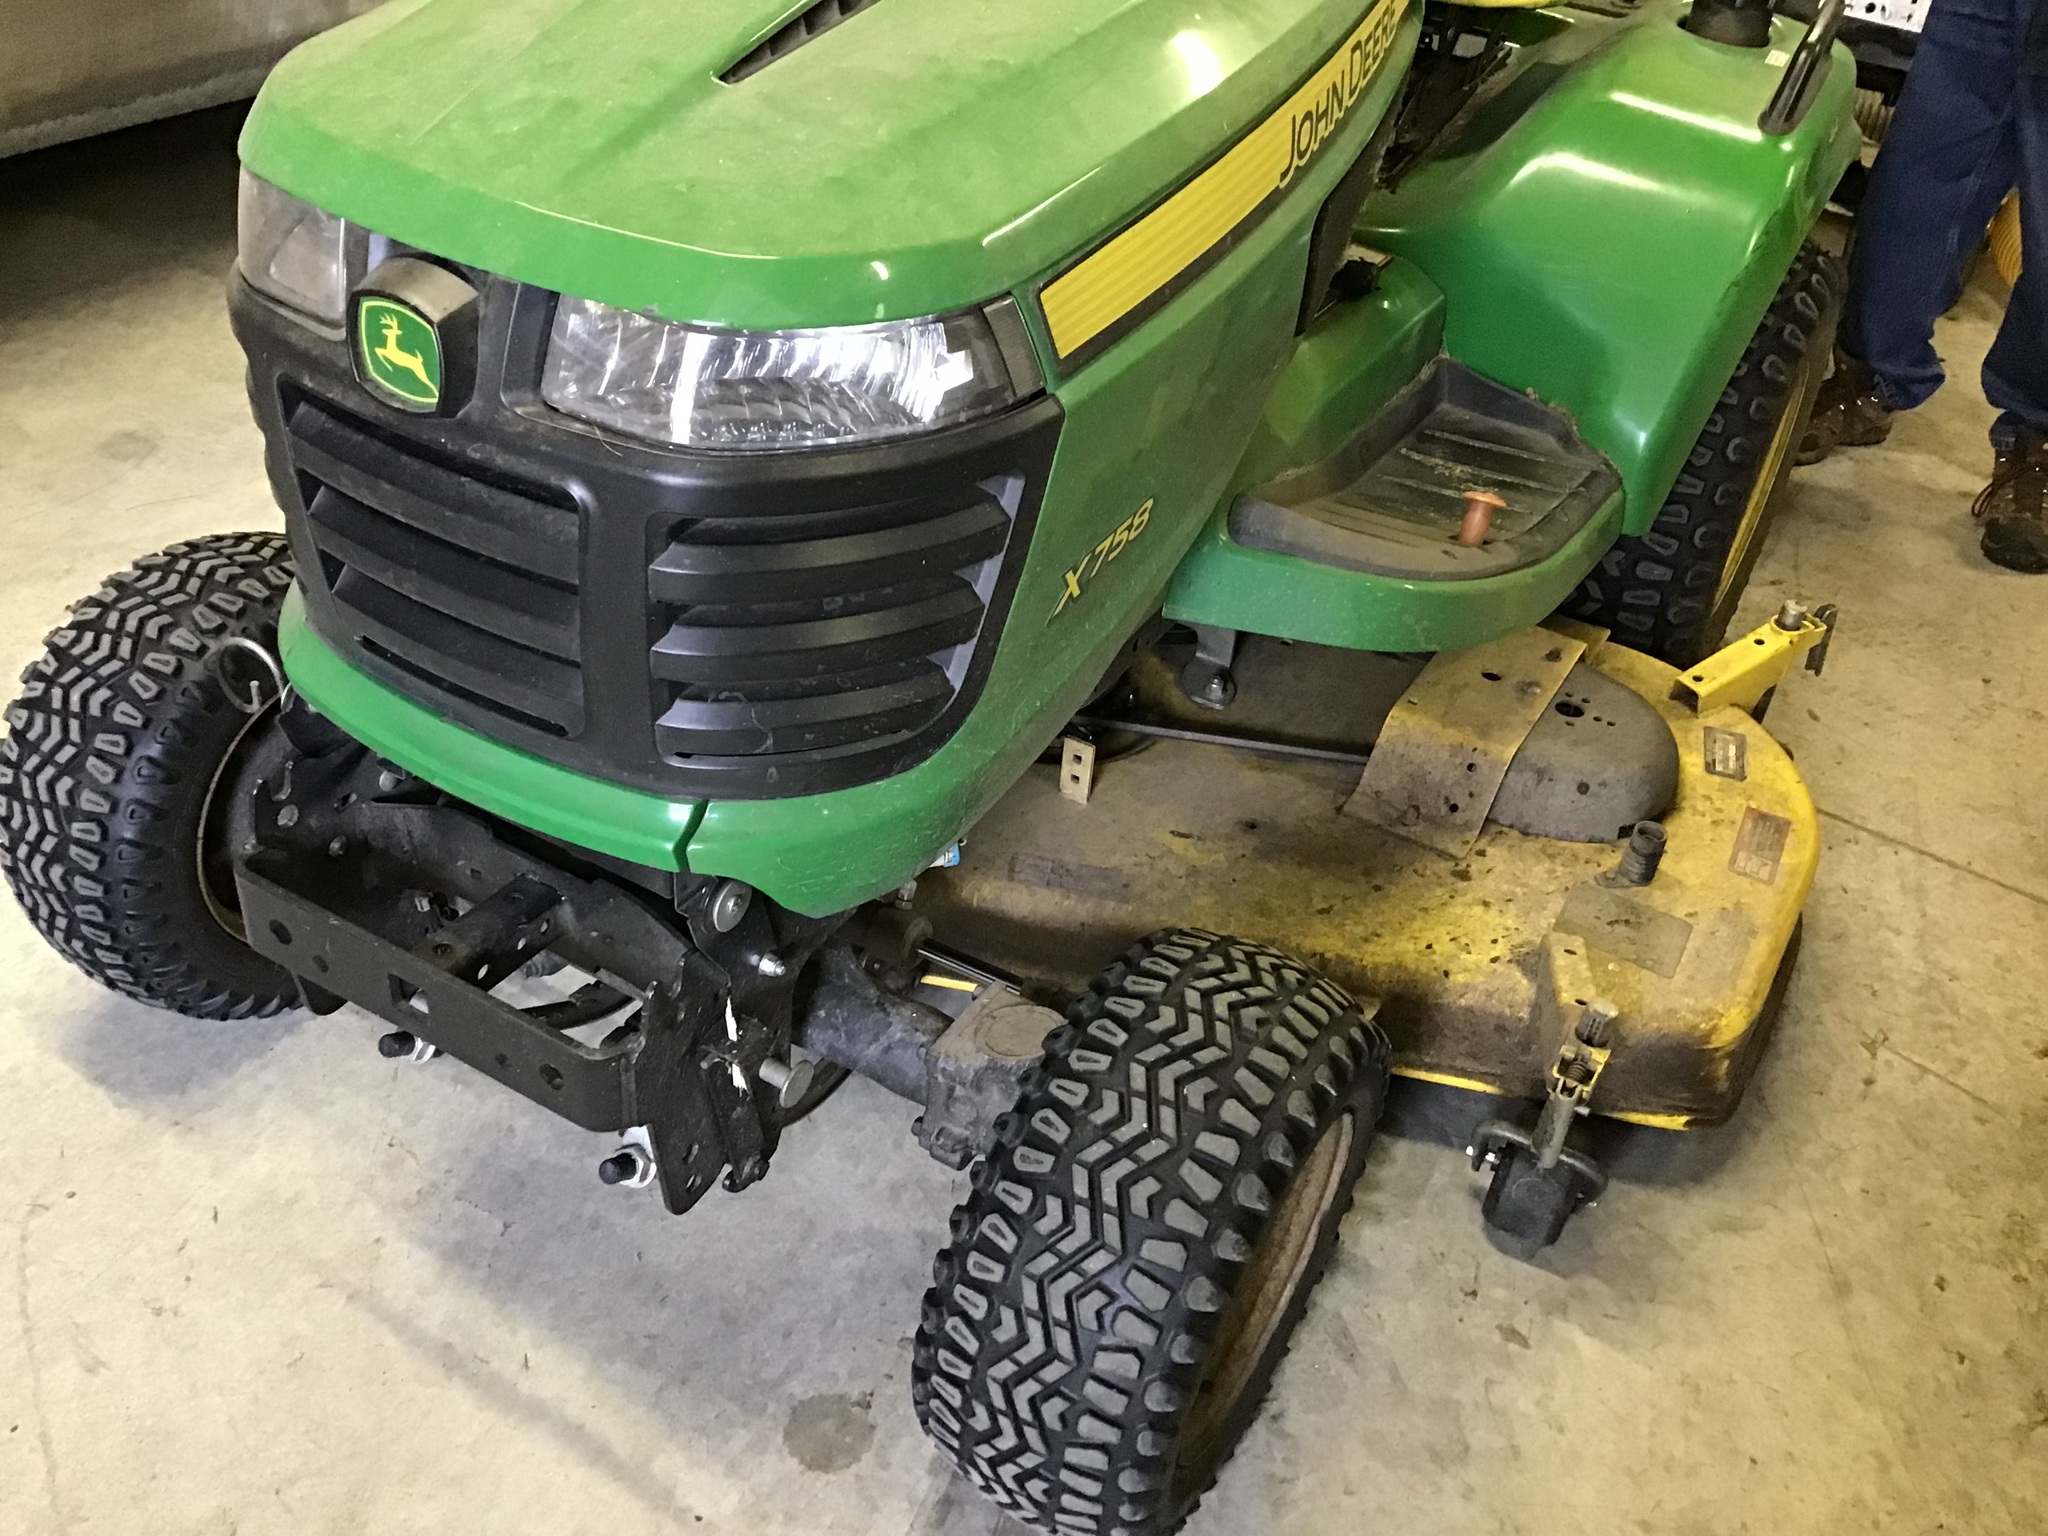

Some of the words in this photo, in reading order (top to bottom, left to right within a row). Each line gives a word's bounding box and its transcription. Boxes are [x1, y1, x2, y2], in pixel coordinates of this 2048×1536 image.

[1279, 68, 1346, 185] JOHN
[1348, 0, 1396, 103] DEERE
[1051, 497, 1154, 619] X758
